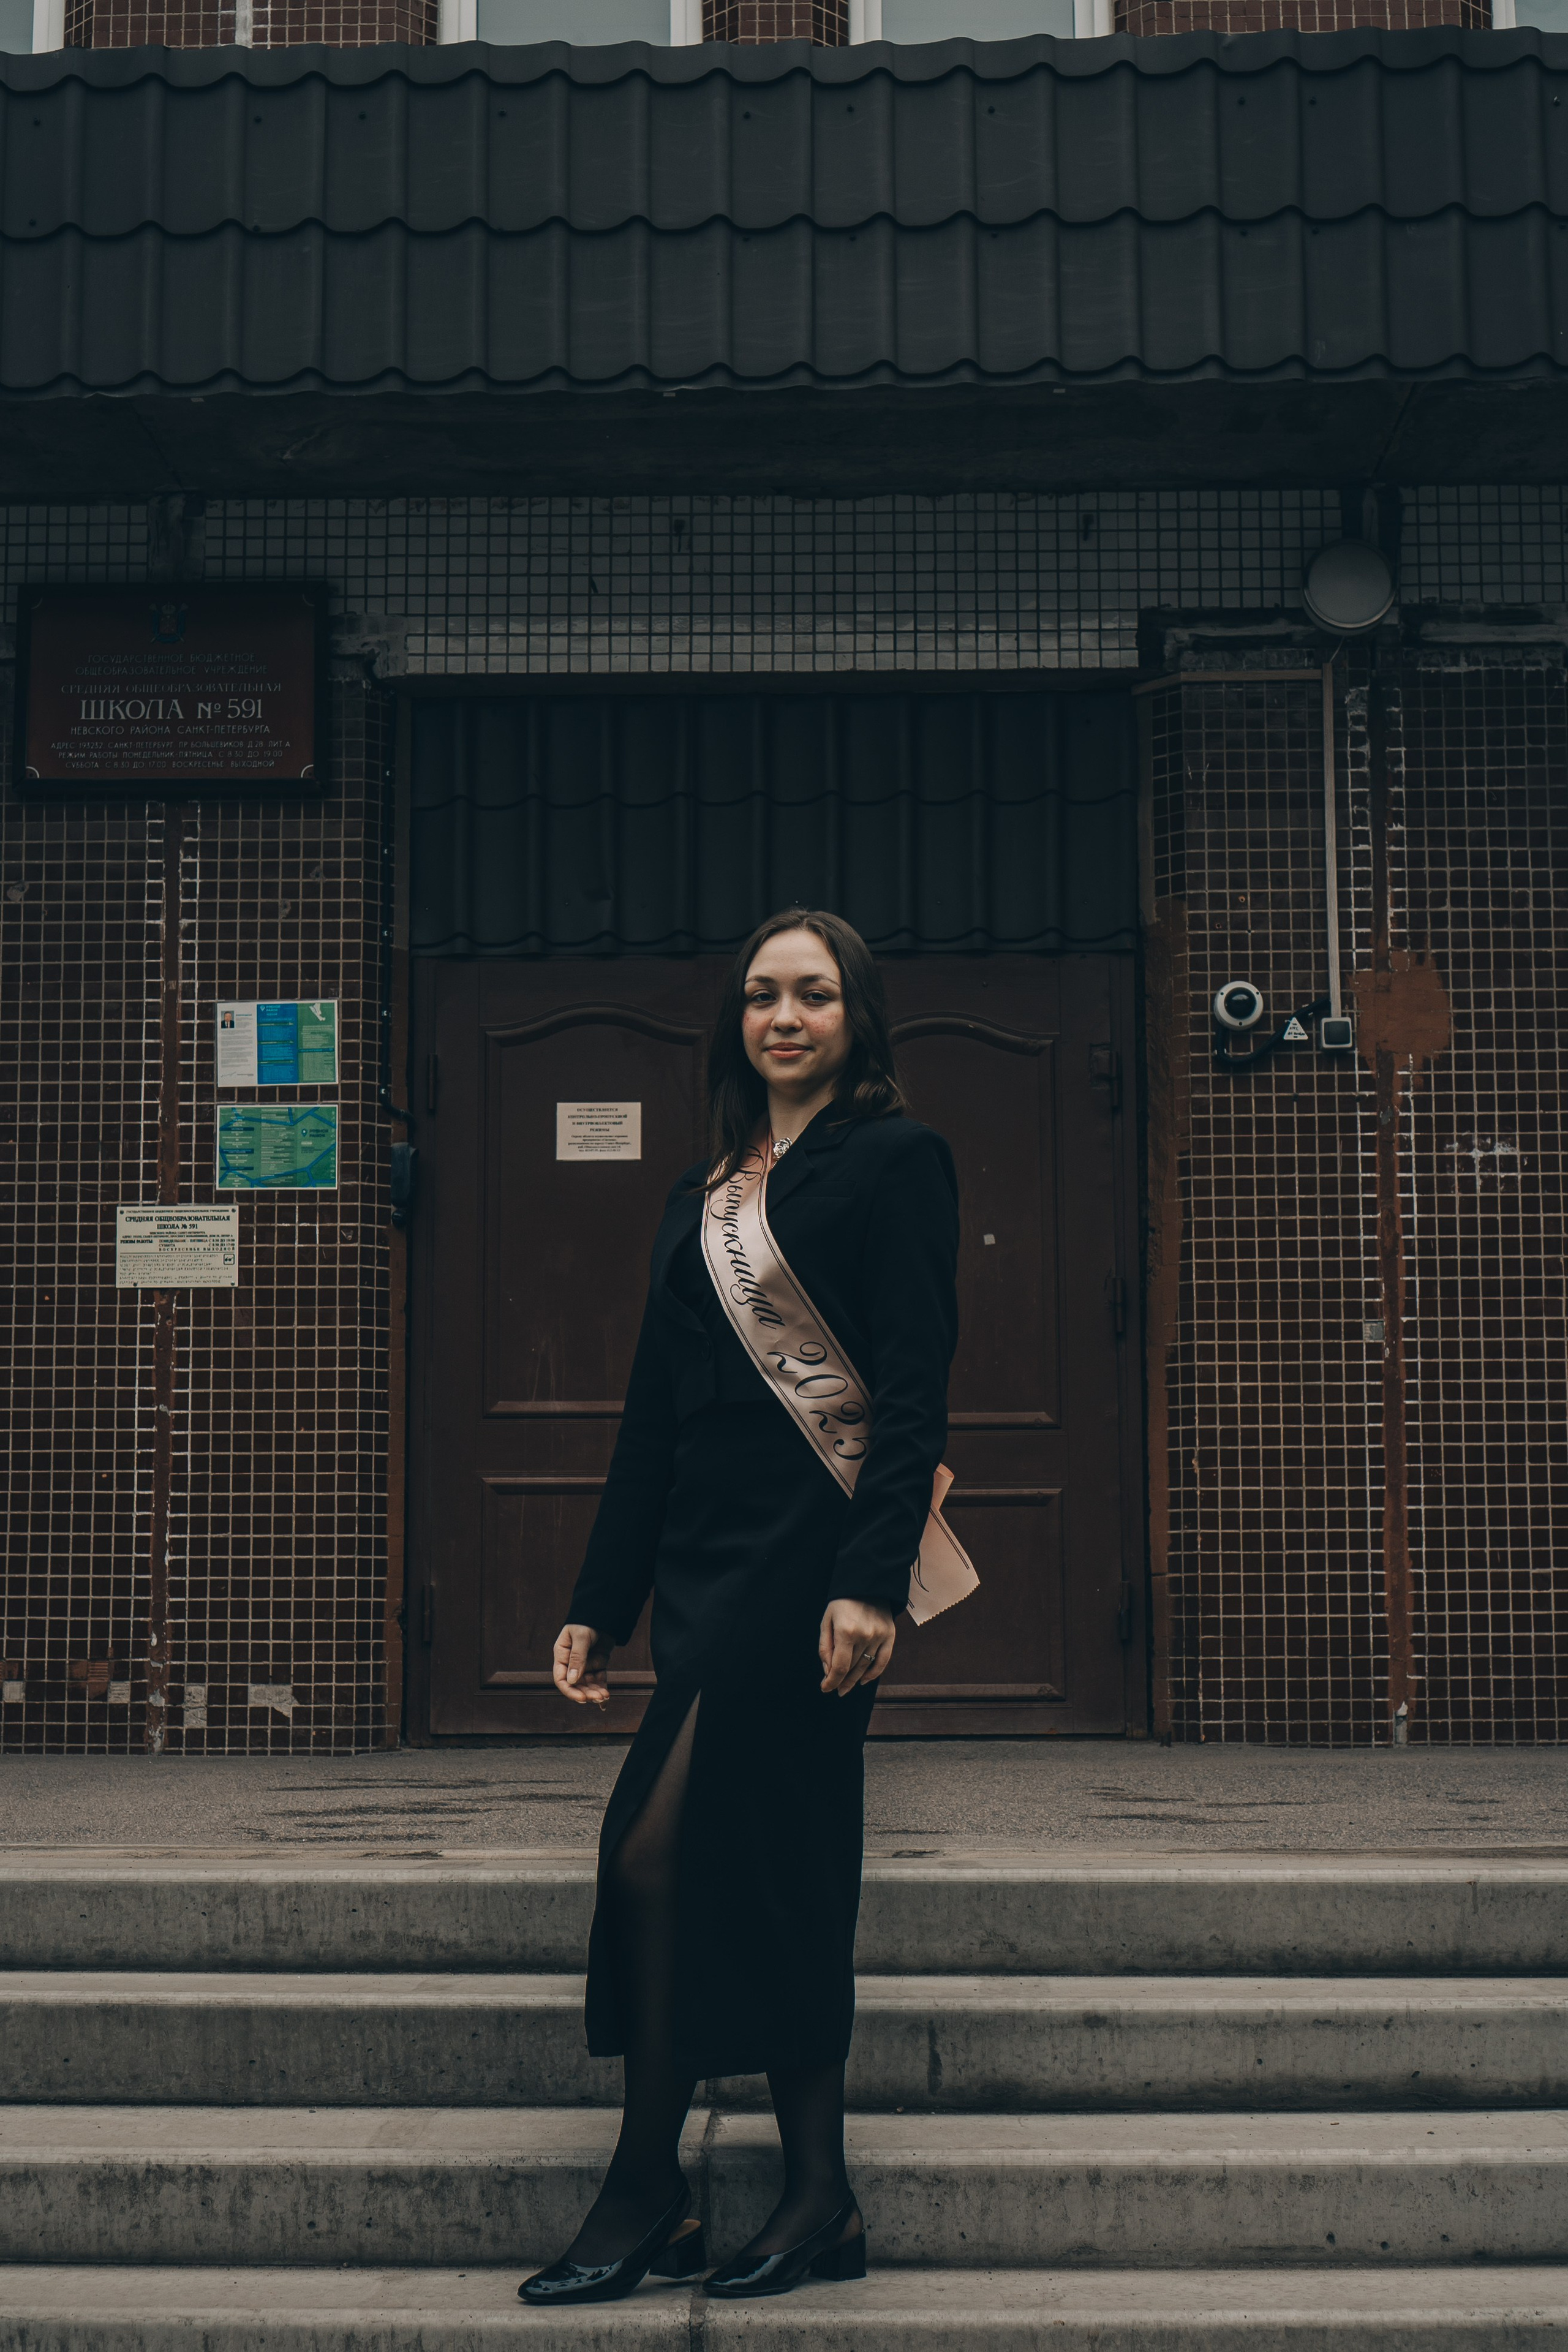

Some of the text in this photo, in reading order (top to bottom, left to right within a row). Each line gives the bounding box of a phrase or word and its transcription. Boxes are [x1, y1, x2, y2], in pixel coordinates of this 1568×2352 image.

[88, 653, 255, 663] ГОСУДАРСТВЕННОЕ БЮДЖЕТНОЕ
[75, 665, 268, 676] ОБЩЕОБРАЗОВАТЕЛЬНОЕ УЧРЕЖДЕНИЕ
[61, 683, 281, 695] СРЕДНЯЯ ОБЩЕОБРАЗОВАТЕЛЬНАЯ
[80, 699, 184, 720] ШКОЛА
[227, 698, 262, 719] 591
[70, 724, 270, 736] НЕВСКОГО РАЙОНА САНКТ-ПЕТЕРБУРГА
[230, 760, 274, 768] ВЫХОДНОЙ
[710, 1145, 870, 1461] Выпускница 2025
